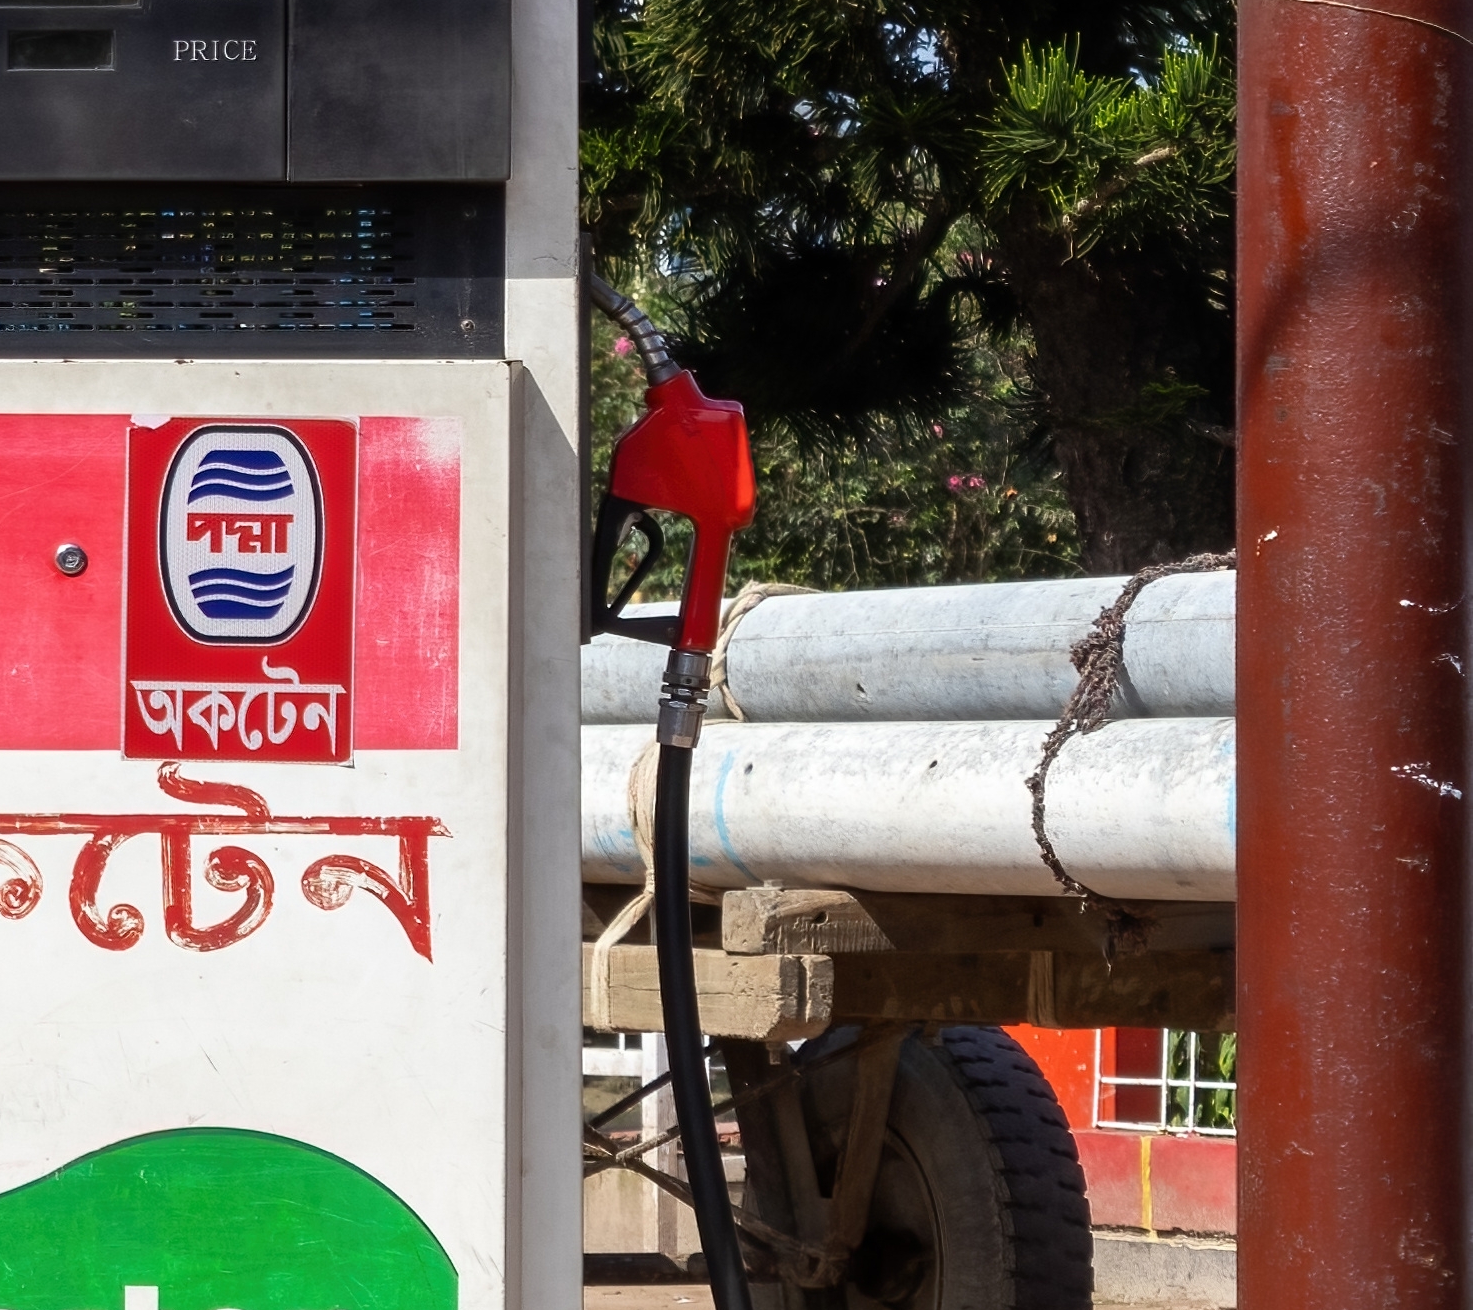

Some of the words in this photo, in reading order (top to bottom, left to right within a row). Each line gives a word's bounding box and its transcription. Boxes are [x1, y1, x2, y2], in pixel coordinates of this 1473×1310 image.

[173, 39, 257, 62] PRICE
[187, 514, 294, 553] পদ্মা
[129, 655, 348, 757] অকটেন
